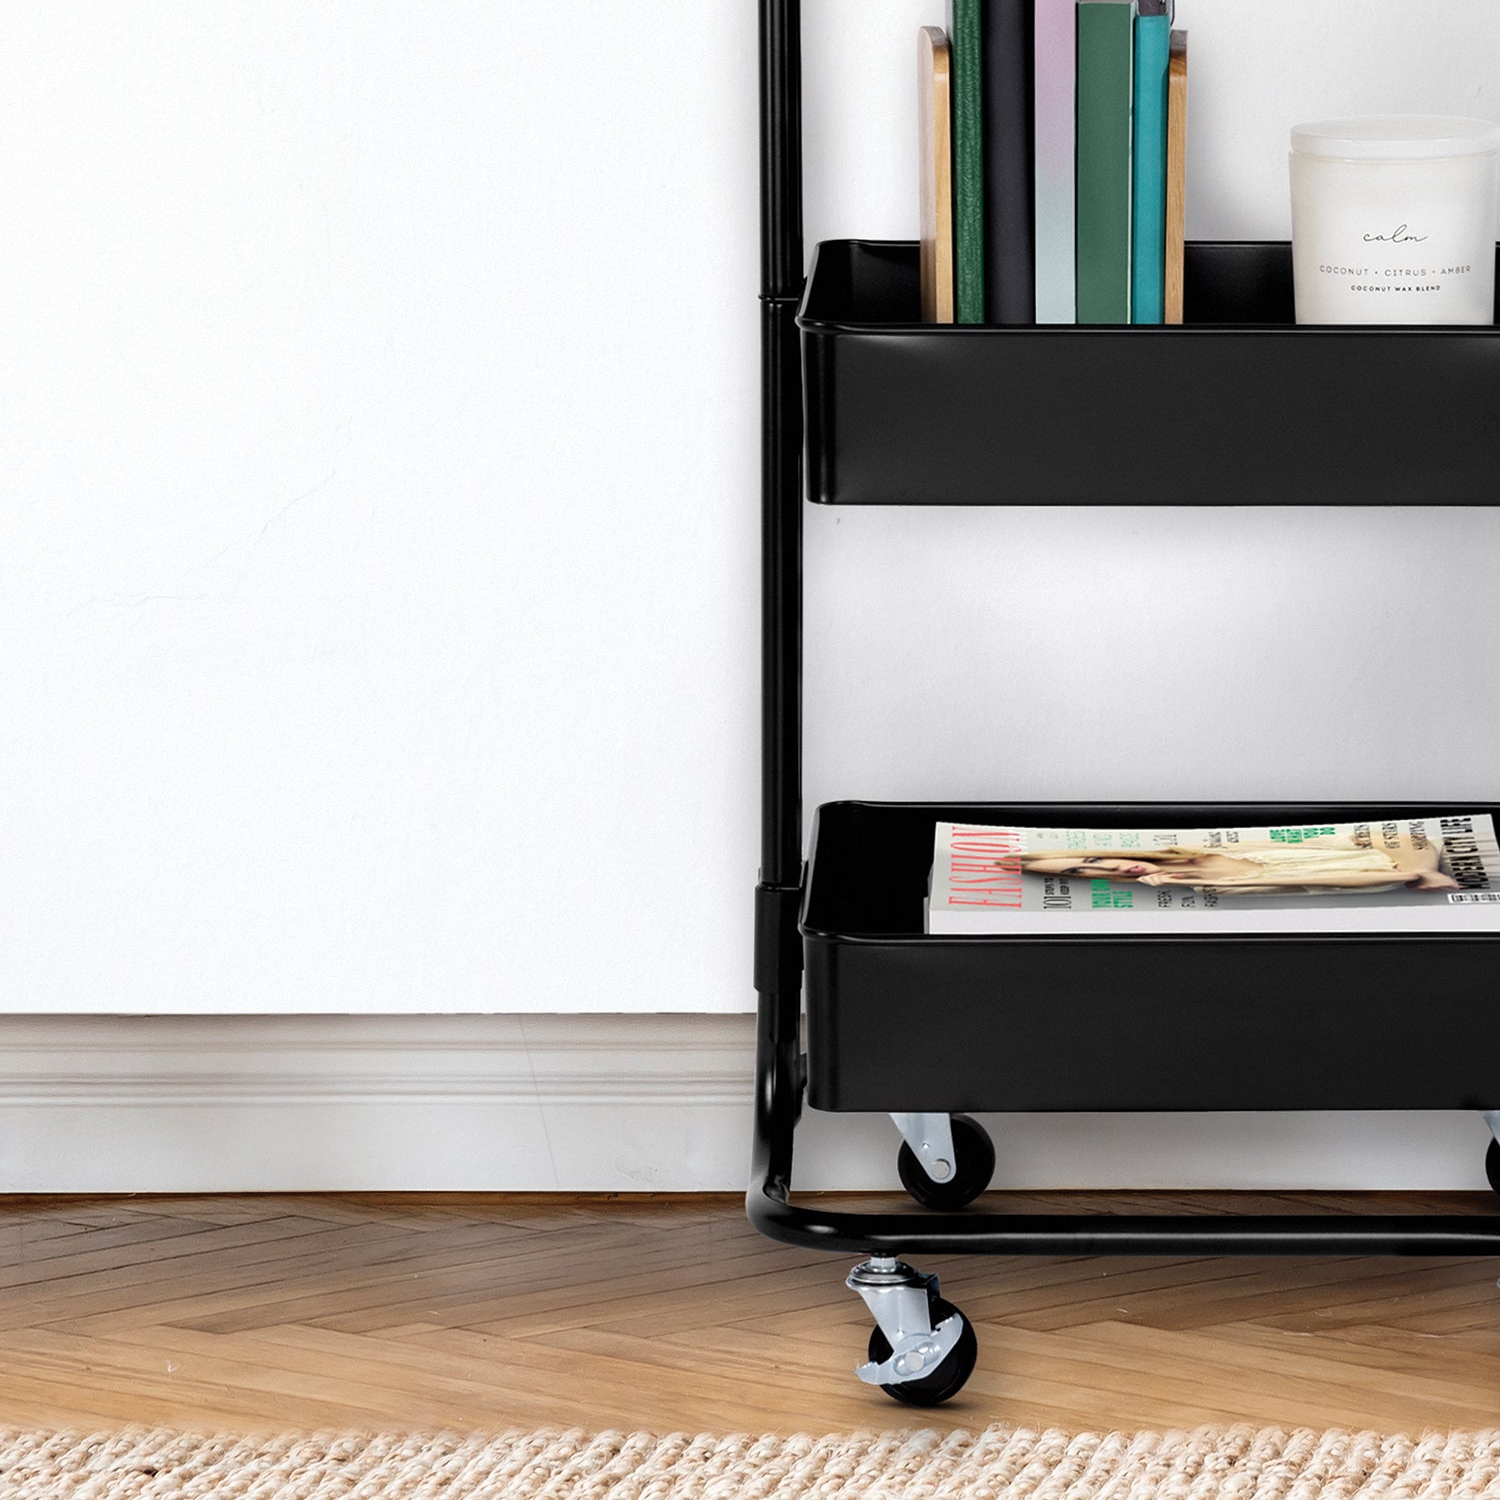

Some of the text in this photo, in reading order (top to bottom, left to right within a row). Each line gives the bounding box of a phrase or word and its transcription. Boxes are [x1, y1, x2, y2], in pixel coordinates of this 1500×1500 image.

[1363, 224, 1429, 243] calm
[1319, 264, 1472, 277] COCONUT CITRUS AMBER
[1350, 284, 1391, 292] COCONUT
[1415, 284, 1441, 292] BLEND
[1440, 817, 1492, 890] MODERN CITY LIFE
[948, 826, 1024, 908] FASHION
[1043, 895, 1072, 909] 101
